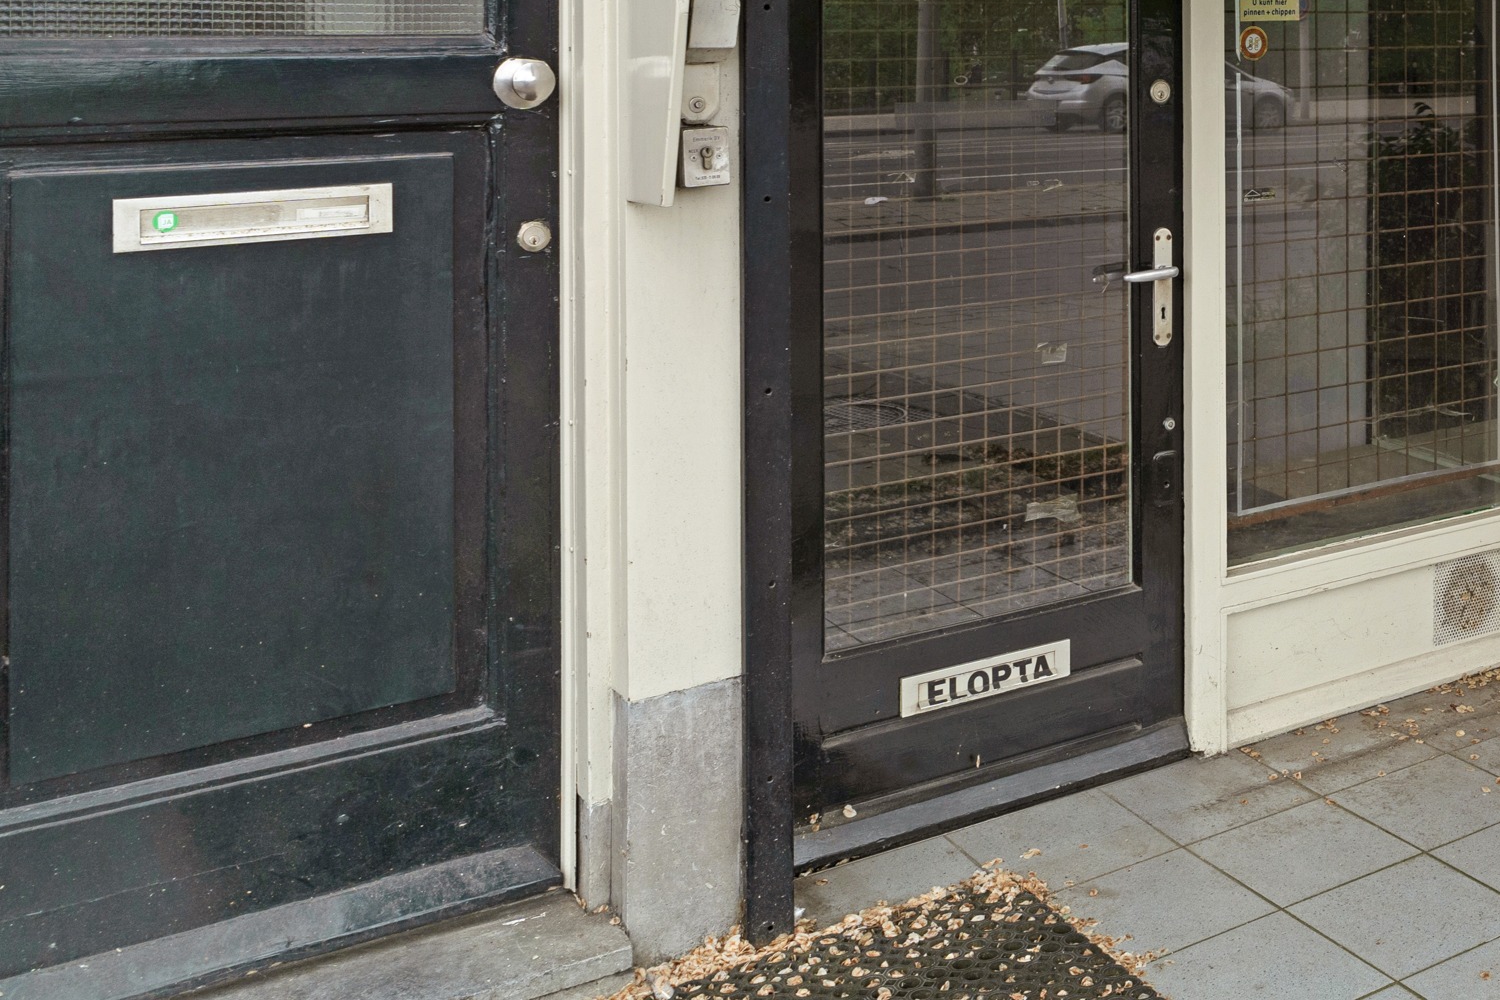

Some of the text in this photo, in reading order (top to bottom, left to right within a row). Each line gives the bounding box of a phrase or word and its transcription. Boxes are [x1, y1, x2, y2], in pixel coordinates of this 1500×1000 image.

[1243, 8, 1265, 17] pinnen
[1272, 8, 1296, 17] chippen
[927, 655, 1053, 706] ELOPTA
